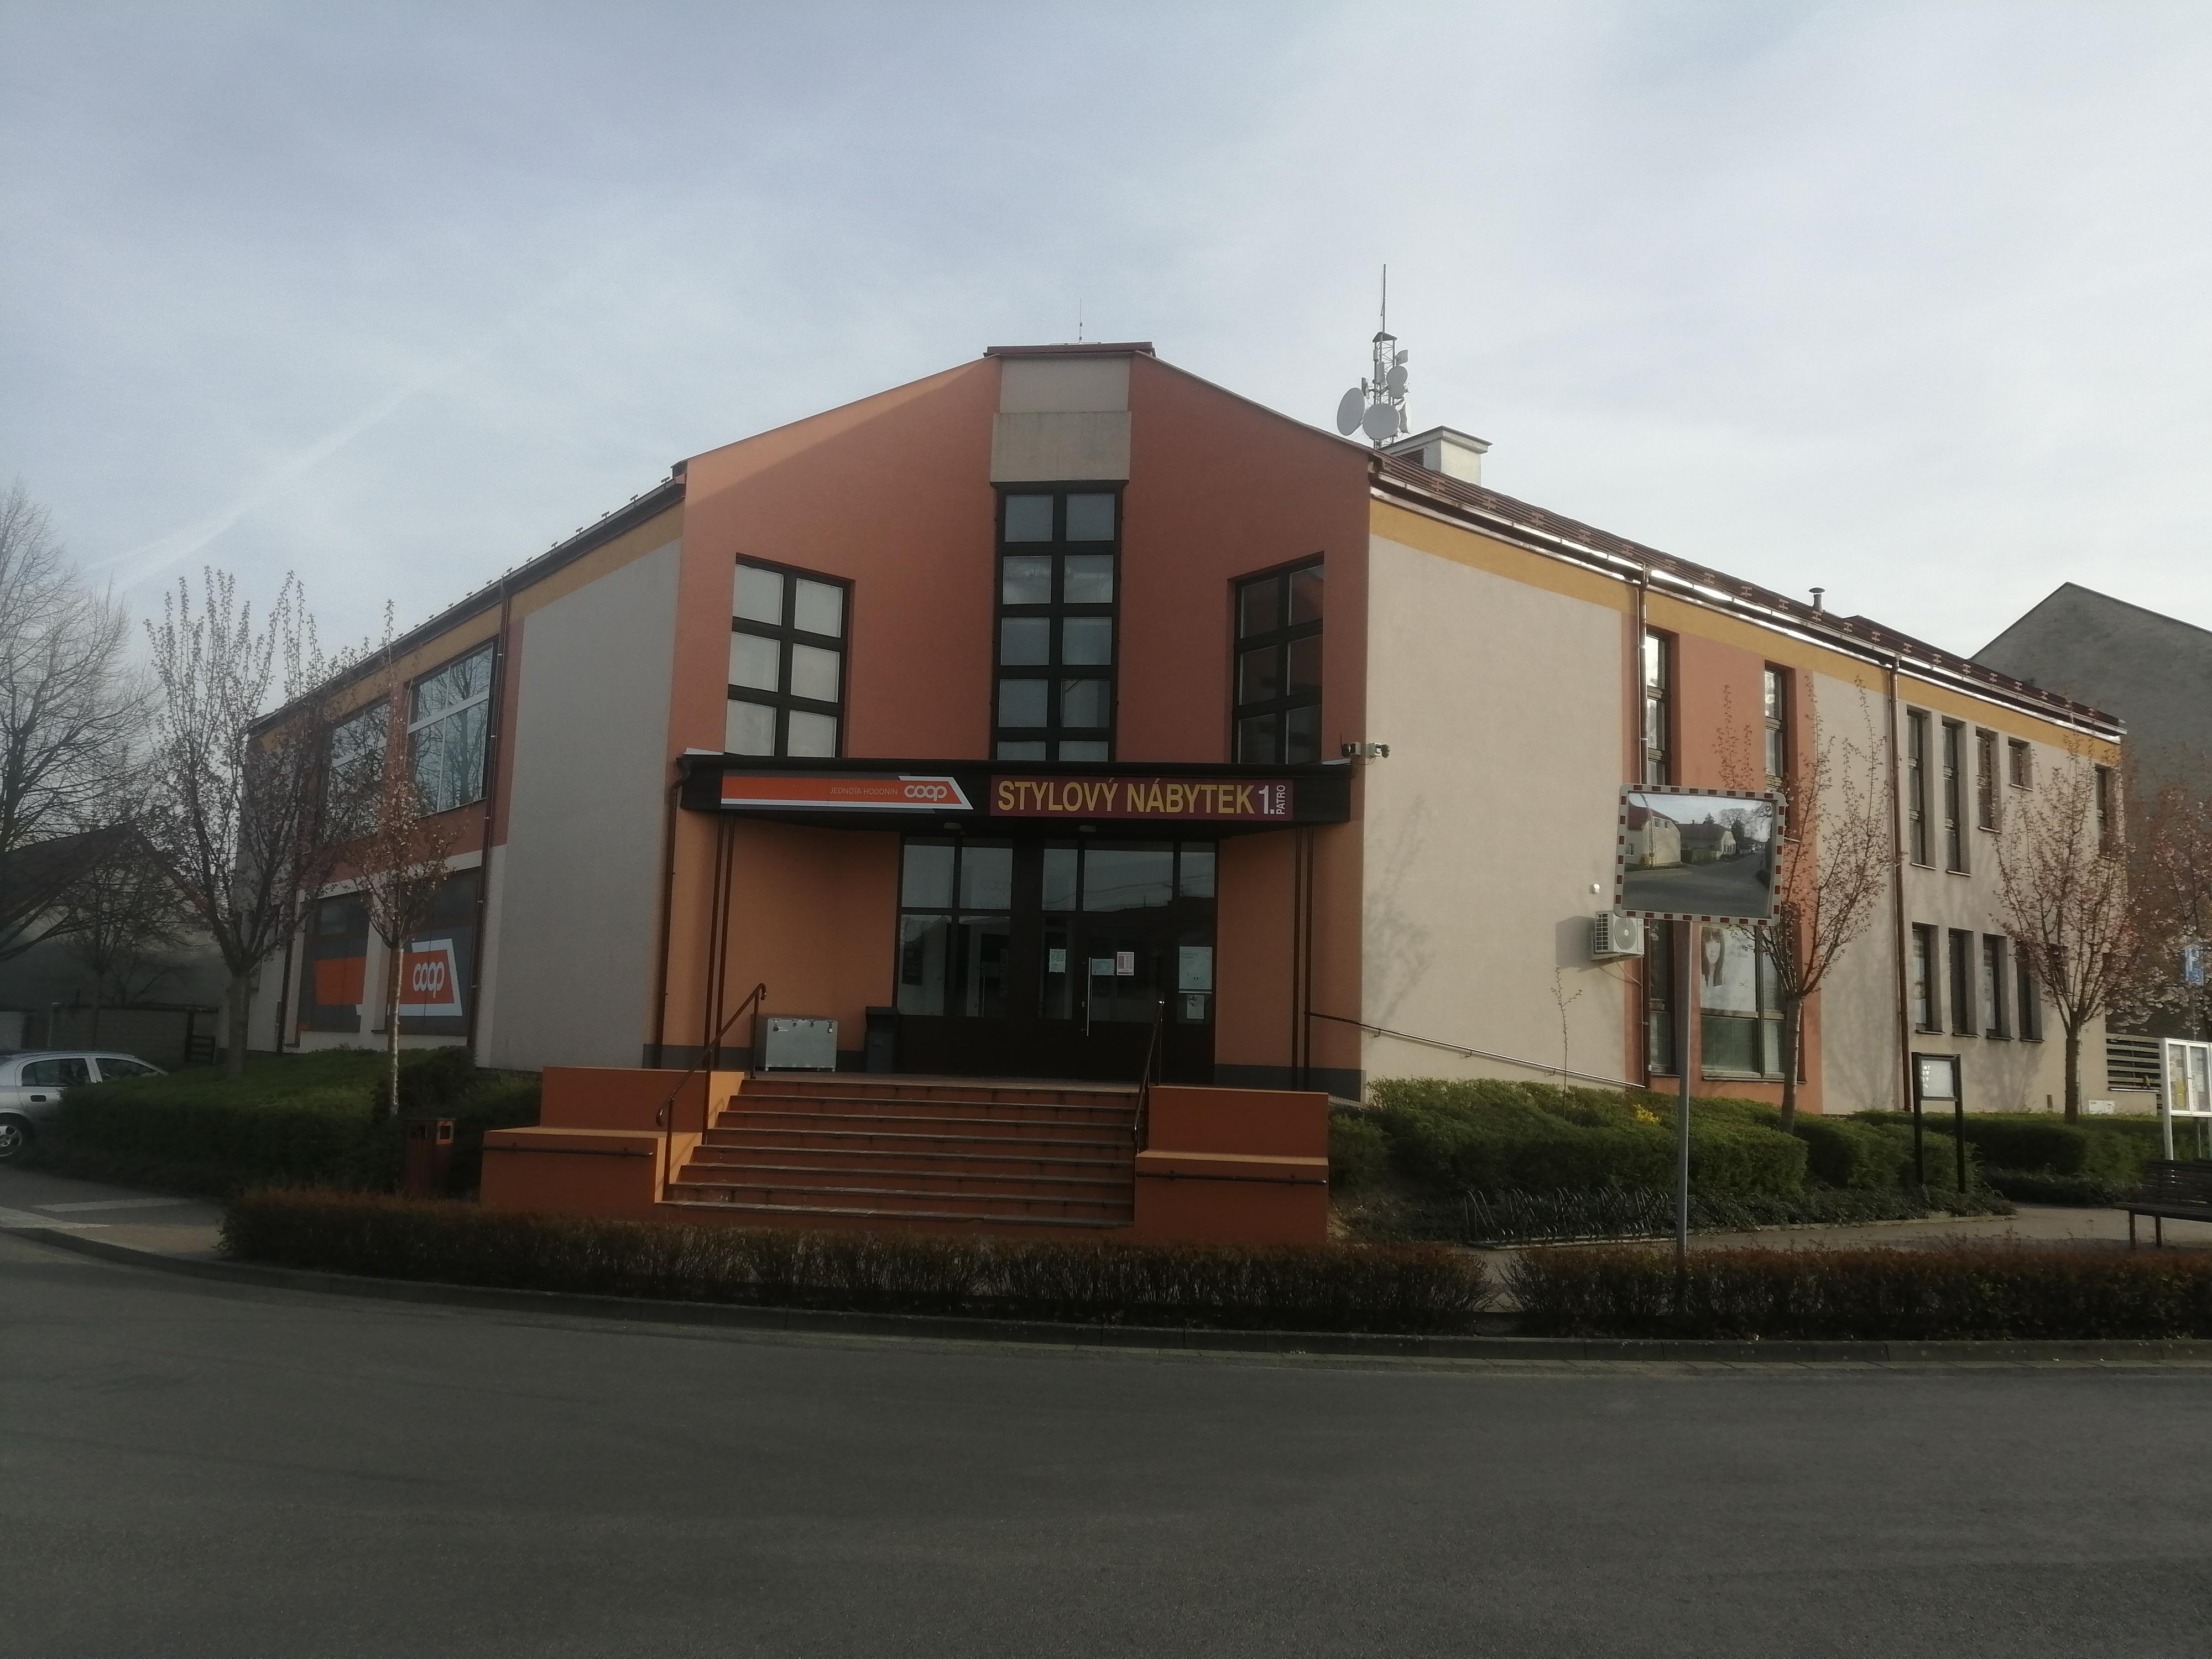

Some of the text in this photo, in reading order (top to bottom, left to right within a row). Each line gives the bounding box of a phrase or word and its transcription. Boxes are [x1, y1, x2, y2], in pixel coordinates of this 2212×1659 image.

[863, 787, 898, 796] HODONÍN
[998, 778, 1285, 814] STYLOVÝ NÁBYTEK 1. PATRO
